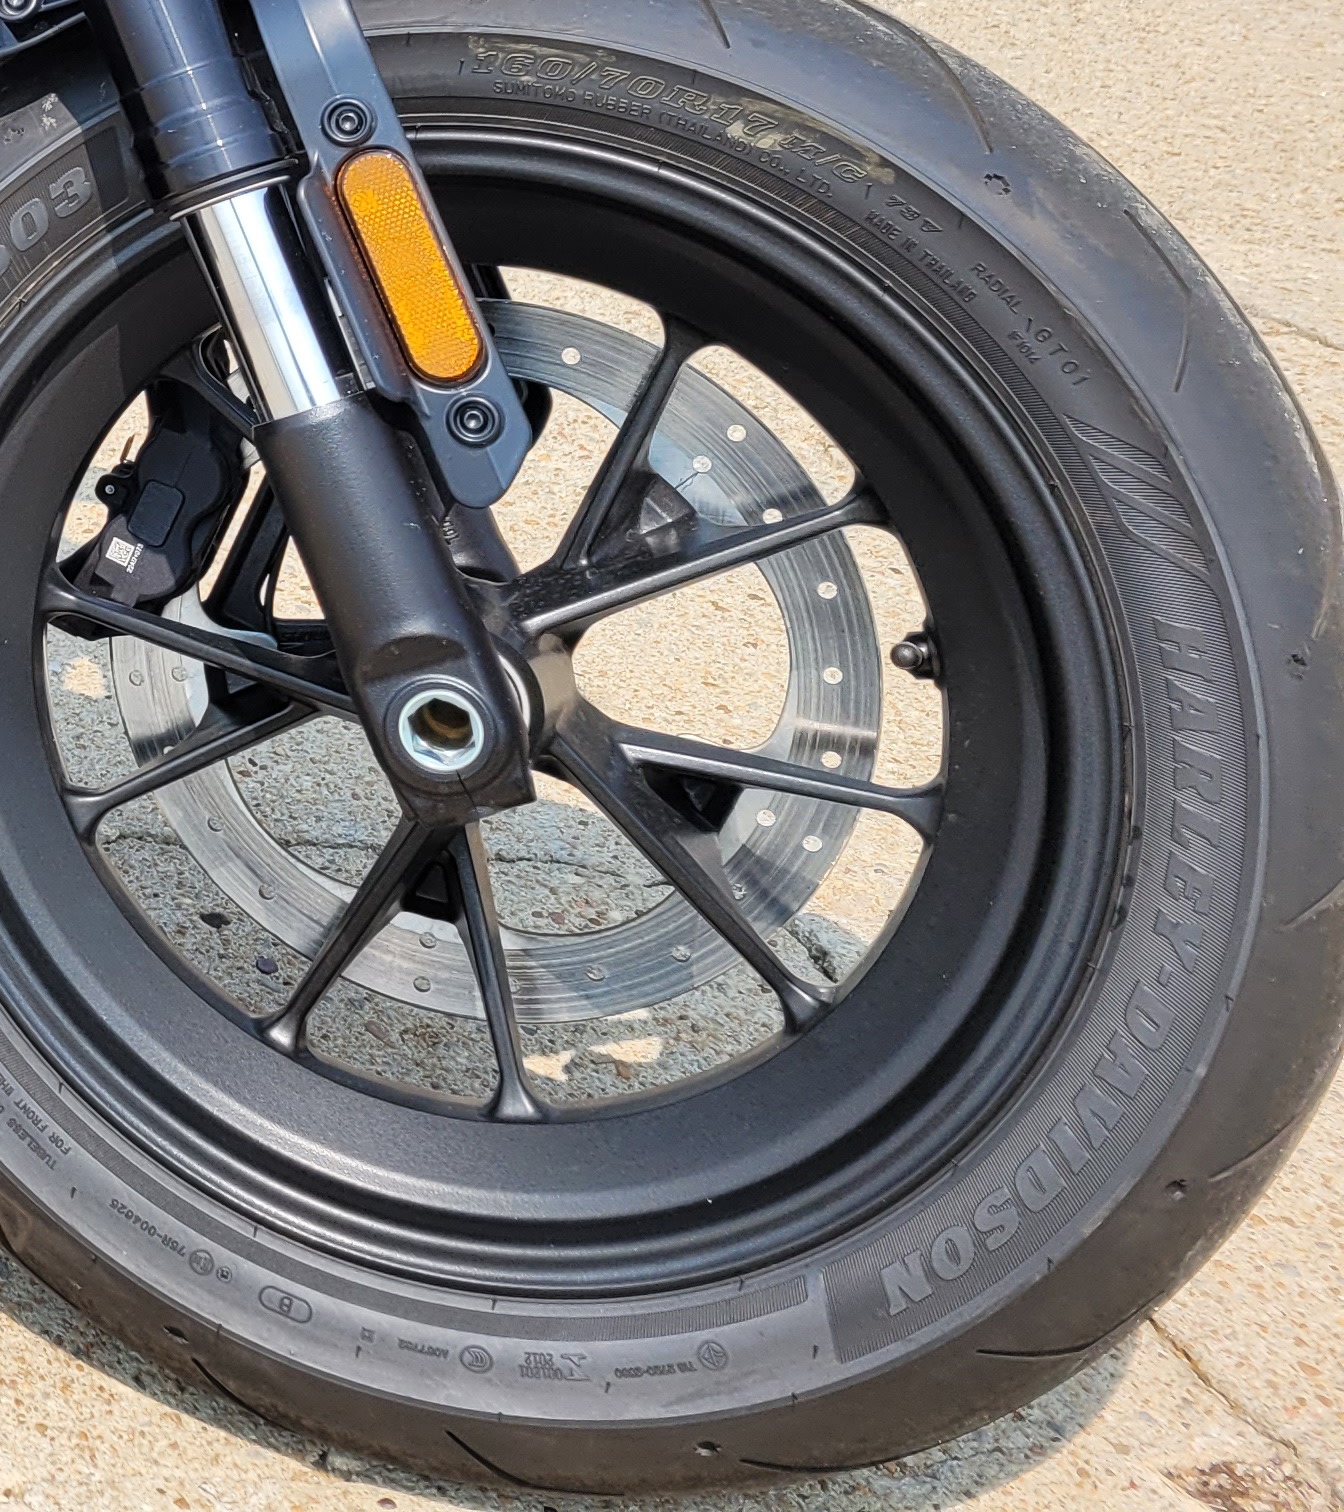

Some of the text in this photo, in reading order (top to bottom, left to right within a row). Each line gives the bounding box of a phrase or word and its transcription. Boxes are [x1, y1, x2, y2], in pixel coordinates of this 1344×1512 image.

[493, 79, 576, 102] SUMITOMO
[583, 90, 652, 121] RUBBER
[970, 261, 1024, 315] RADIAL
[881, 616, 1223, 1317] HARLEY-DAVIDSON
[13, 1098, 50, 1133] FRONT
[47, 1131, 72, 1156] FOR
